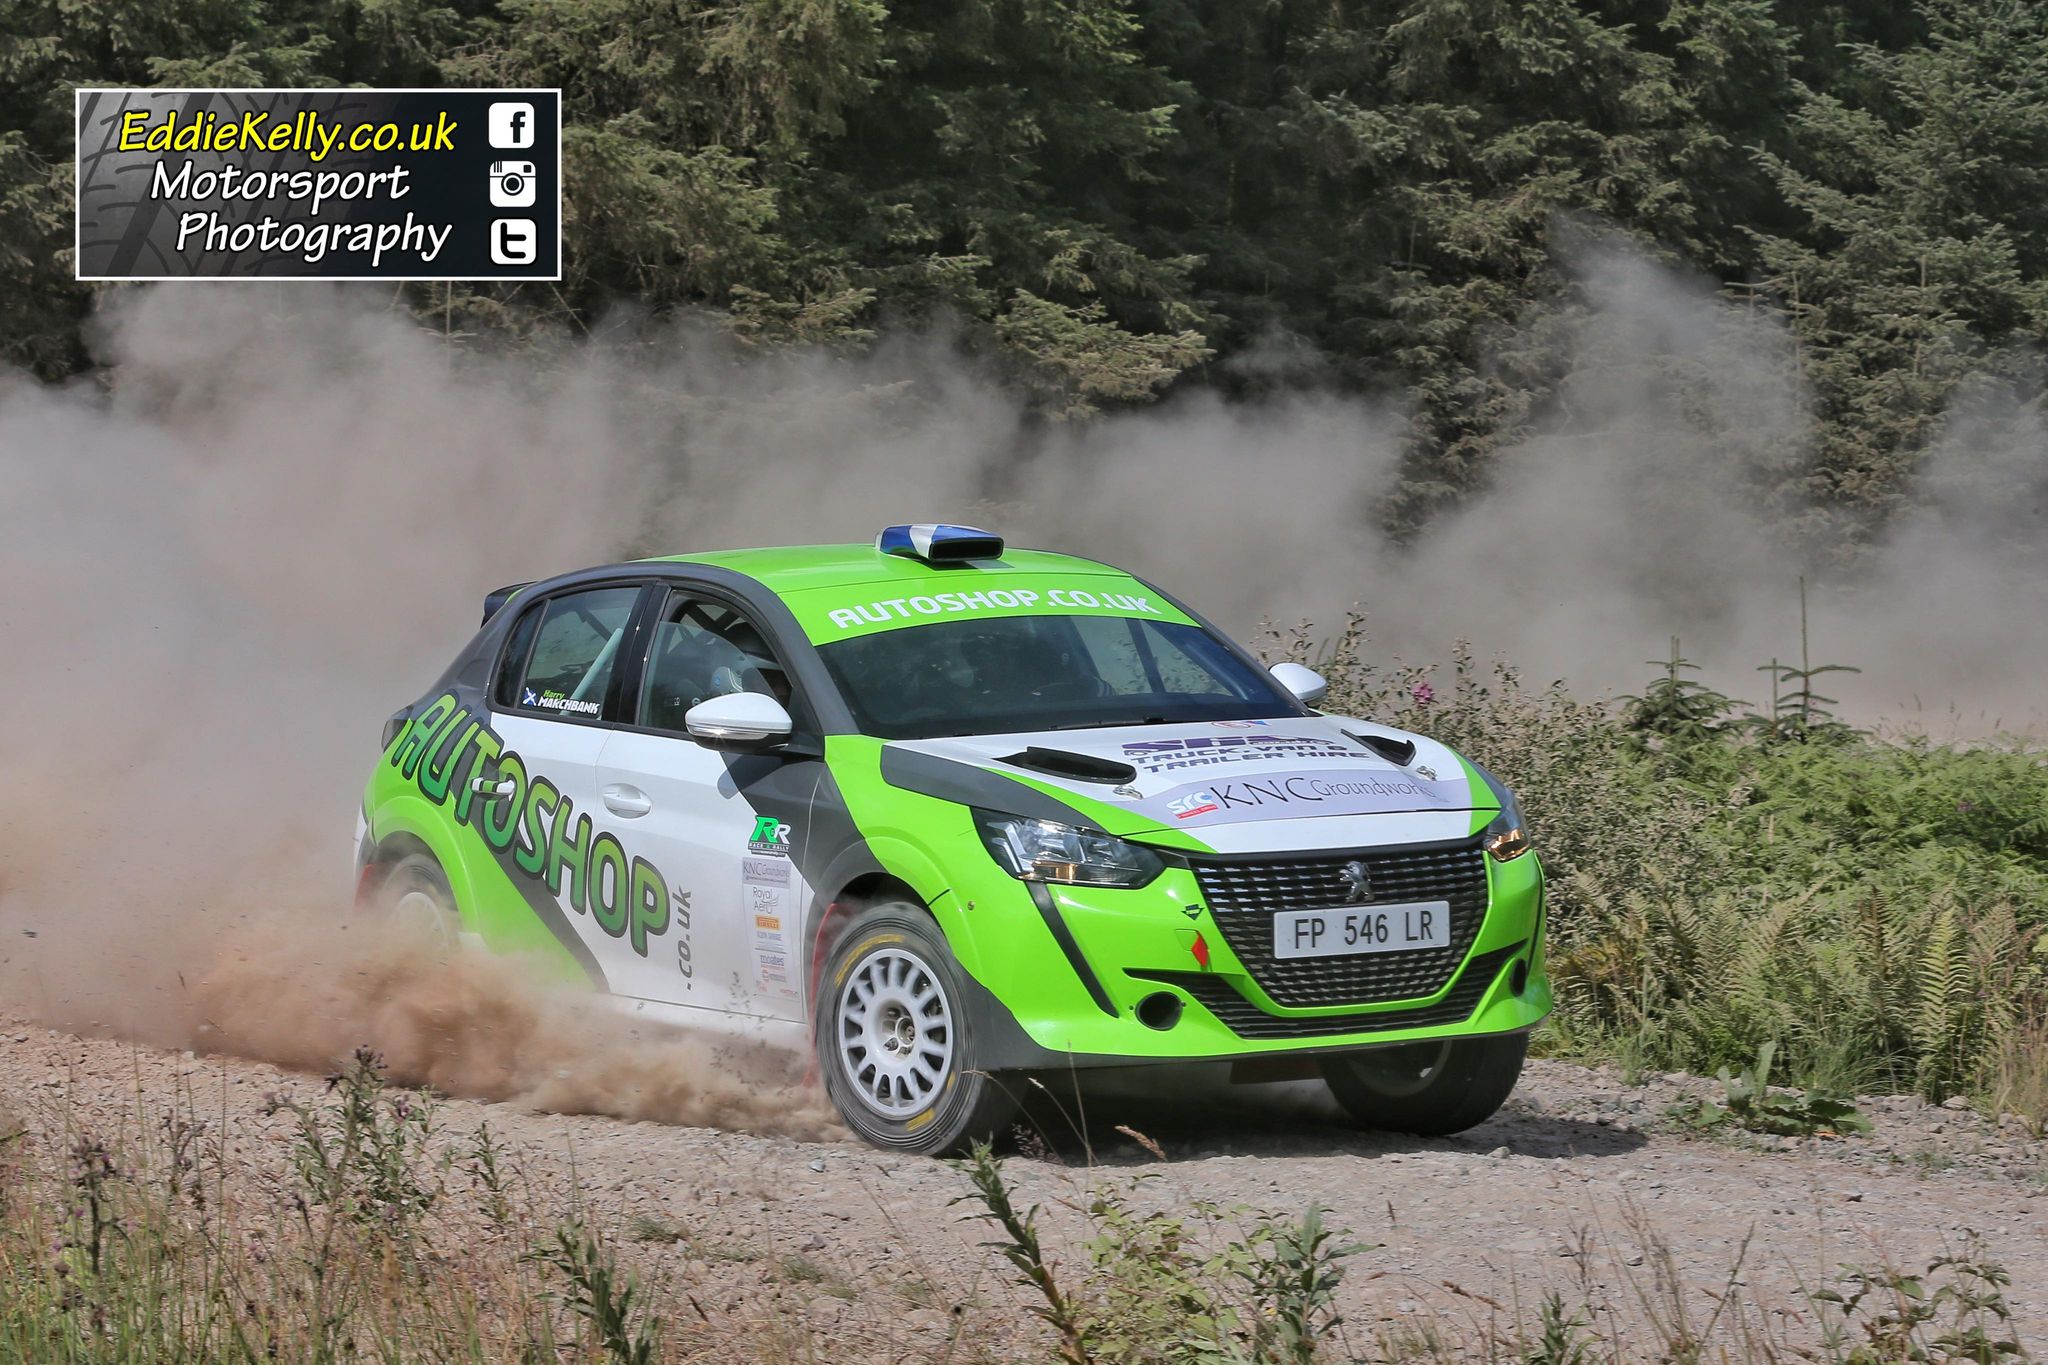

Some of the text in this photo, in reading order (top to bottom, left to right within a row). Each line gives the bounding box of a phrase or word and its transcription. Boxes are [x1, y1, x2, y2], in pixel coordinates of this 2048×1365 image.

[543, 689, 566, 700] Harry
[1144, 752, 1285, 773] TRAILER
[1210, 777, 1323, 808] KNC
[391, 689, 671, 959] AUTOSHOP
[743, 861, 762, 876] KNC
[752, 886, 774, 900] Royal
[672, 885, 693, 991] .co.uk
[1295, 910, 1433, 949] FP 546 LR
